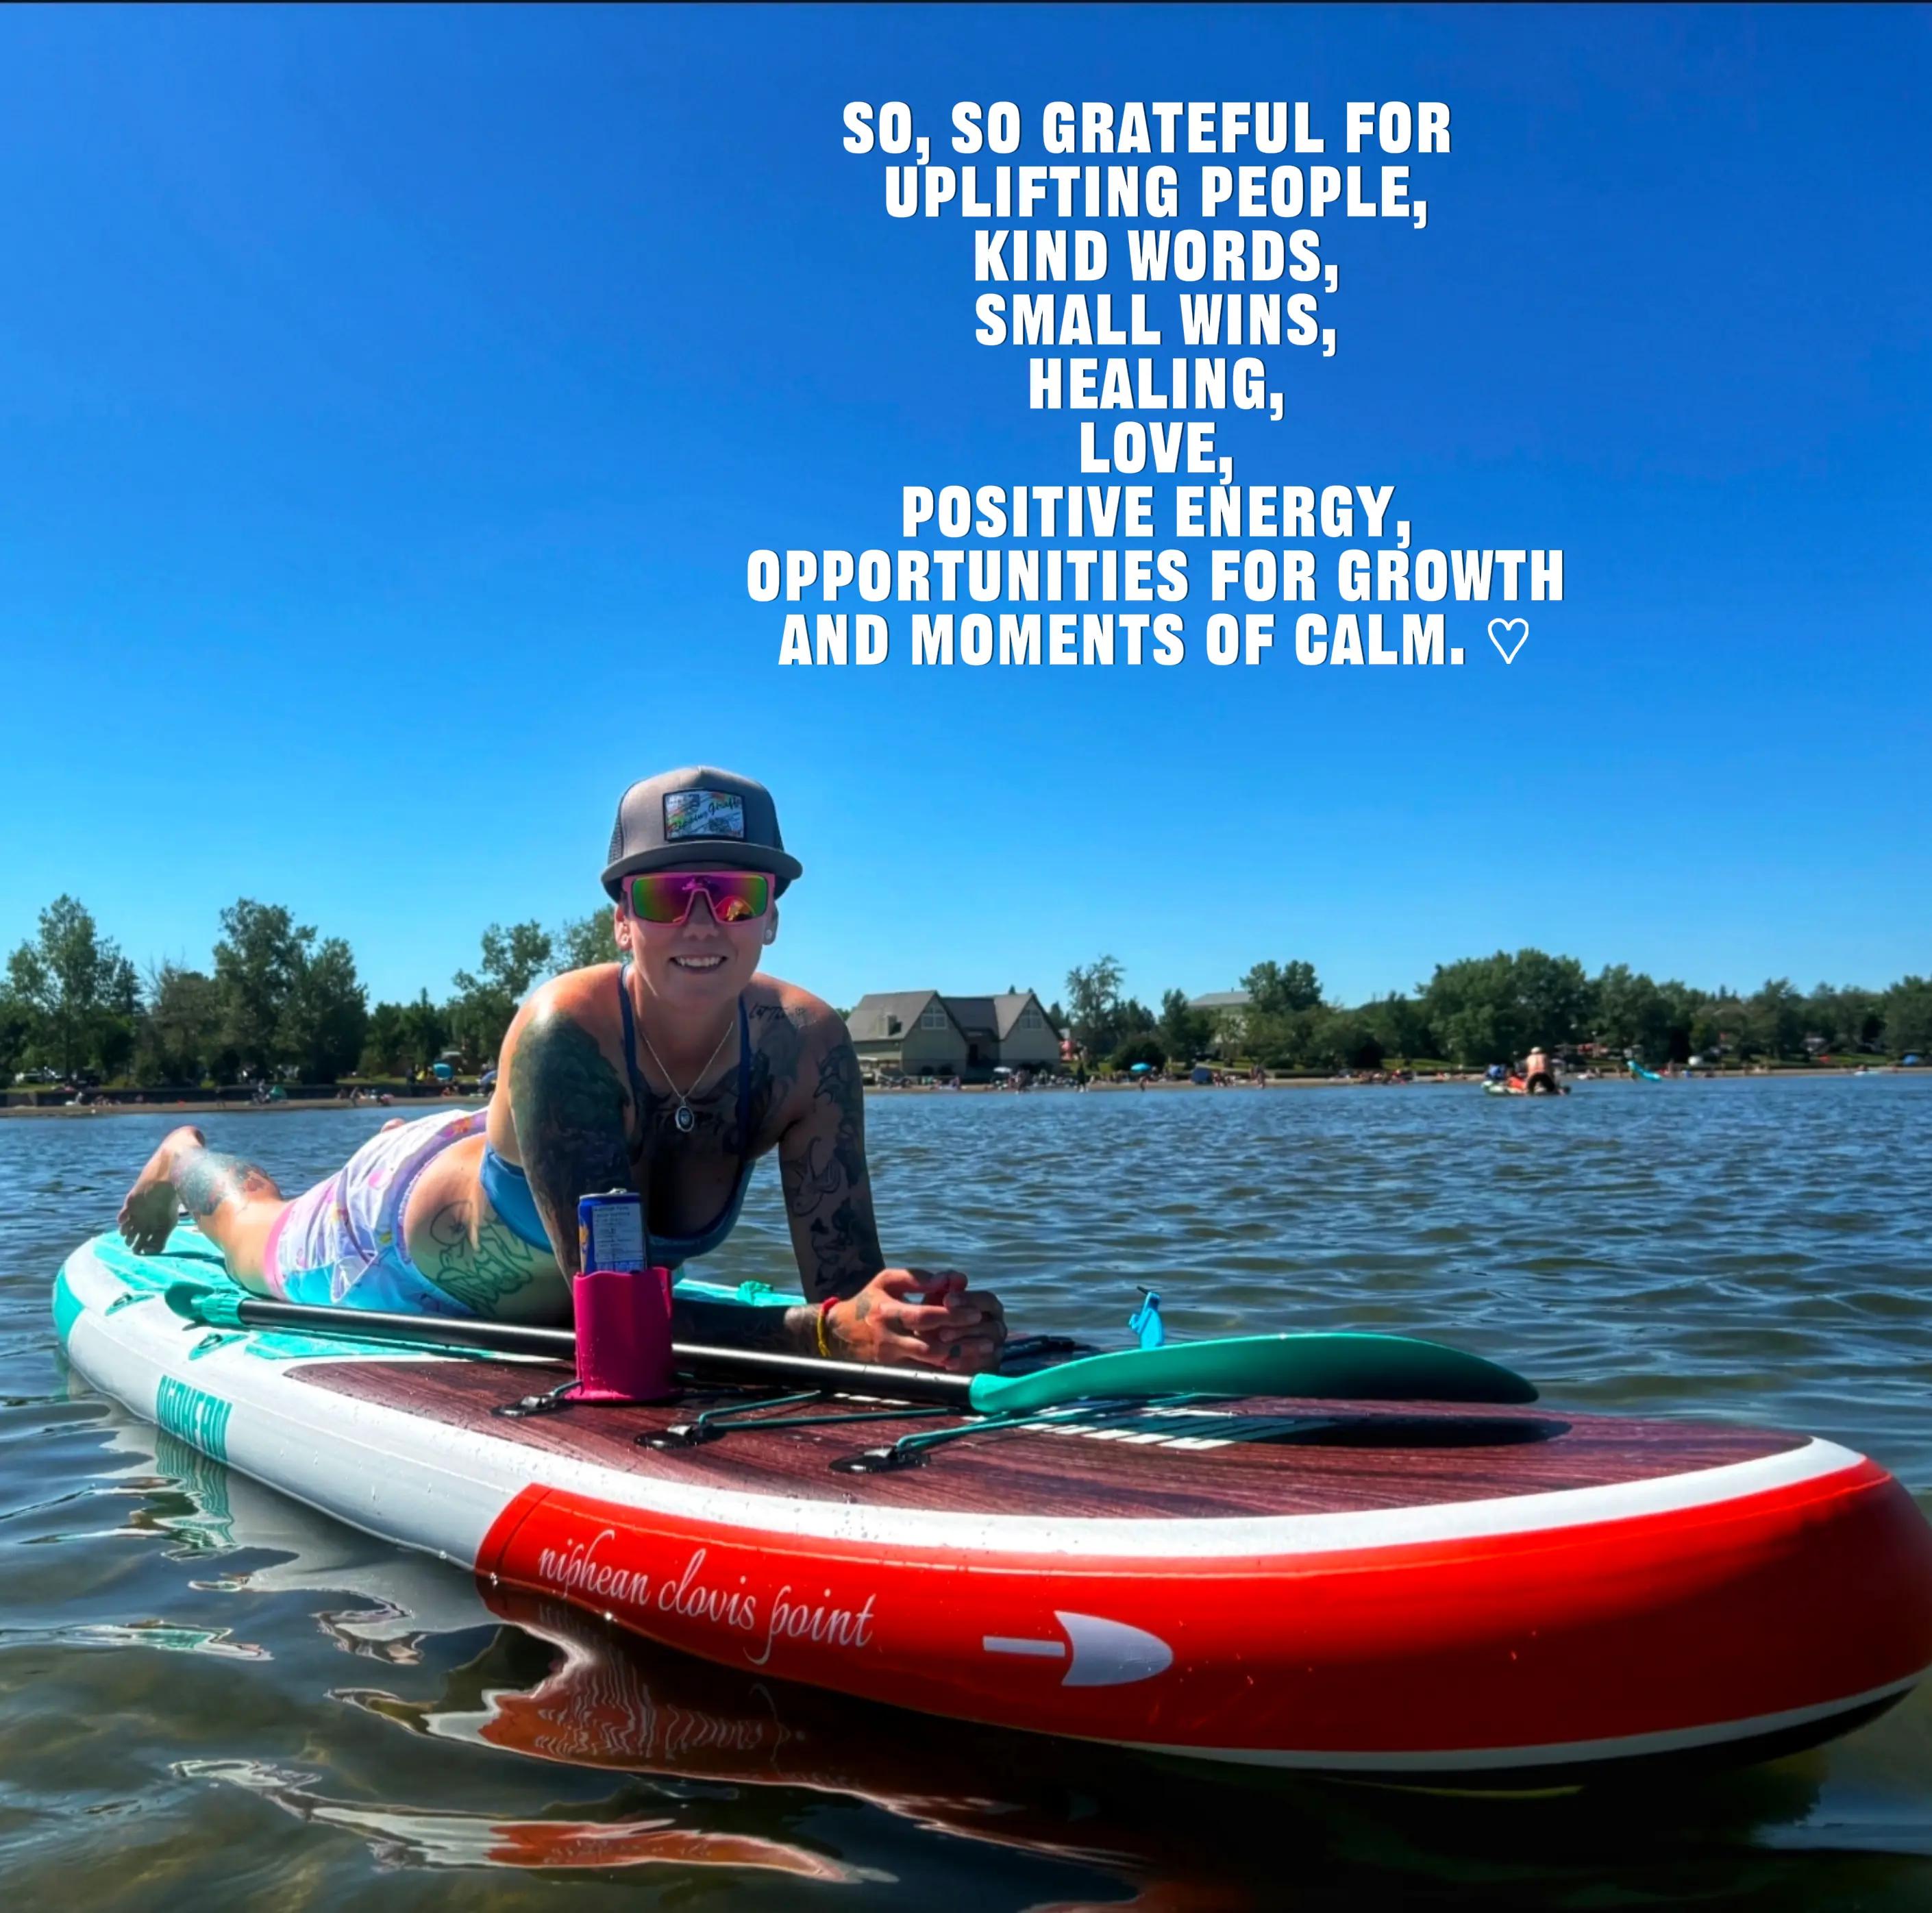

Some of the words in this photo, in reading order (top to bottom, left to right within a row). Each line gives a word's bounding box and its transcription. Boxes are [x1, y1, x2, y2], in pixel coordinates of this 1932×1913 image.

[538, 1529, 651, 1605] niphean
[658, 1547, 757, 1631] clovis
[743, 1584, 877, 1666] point
